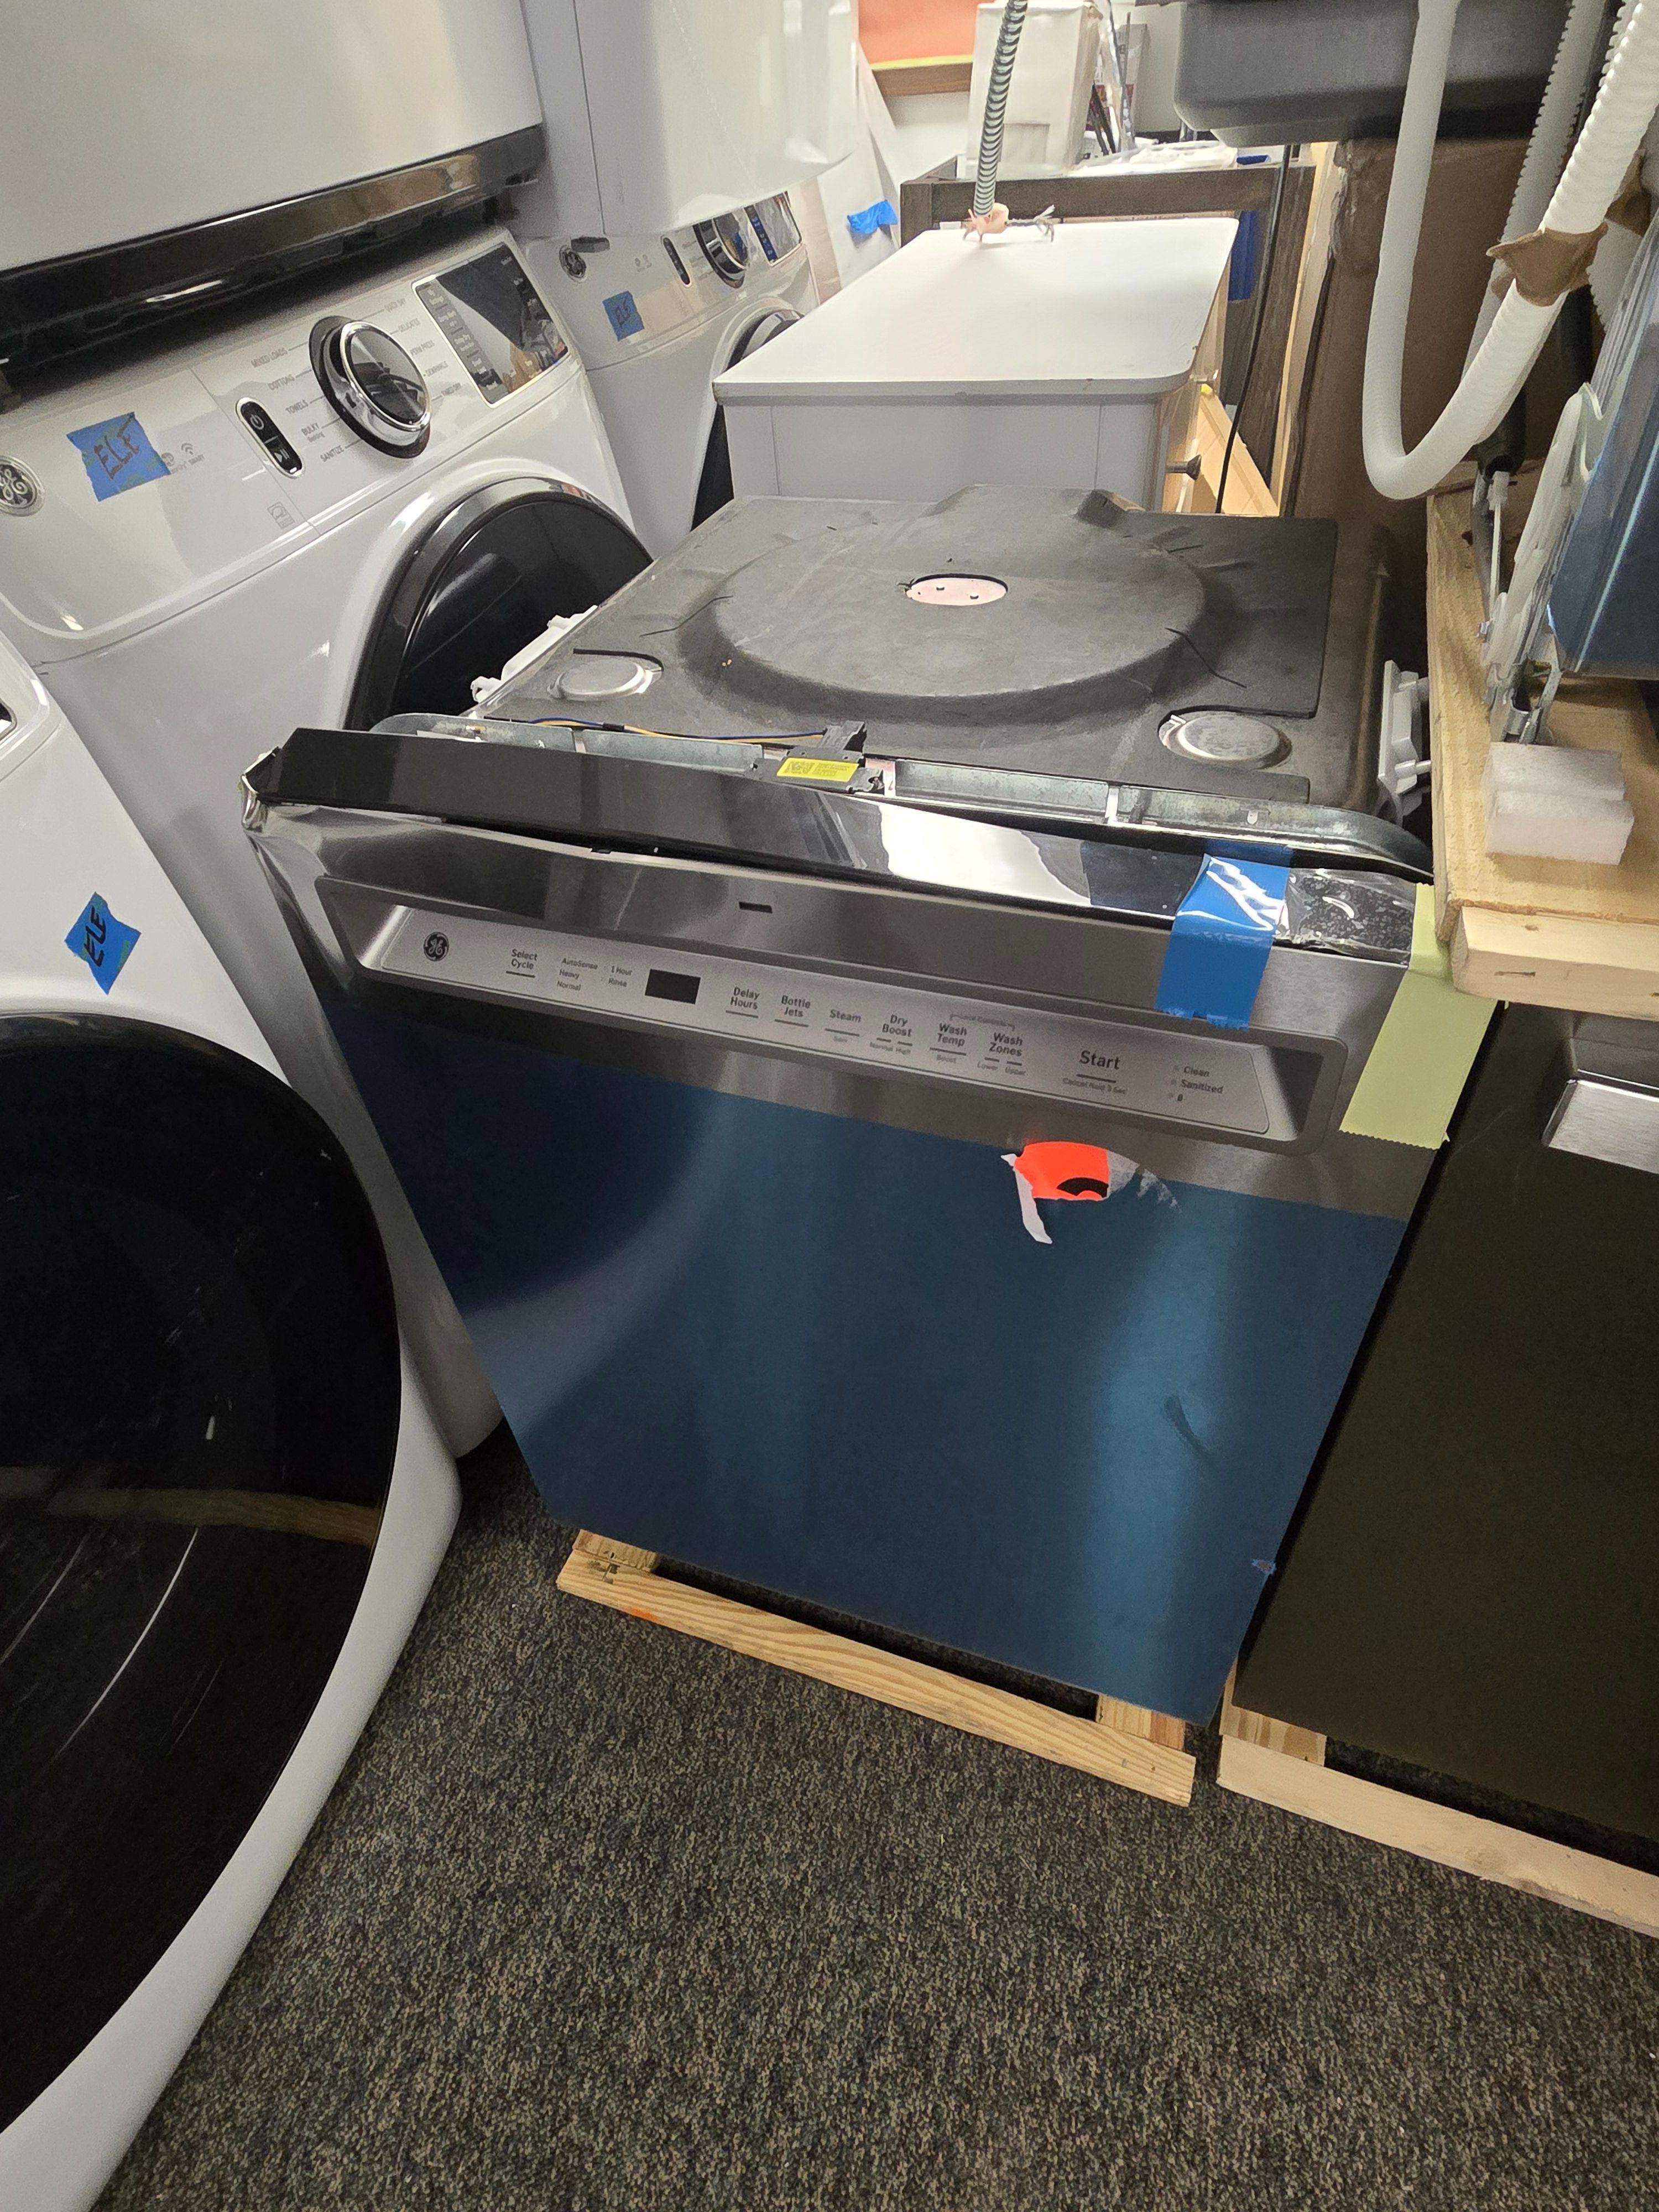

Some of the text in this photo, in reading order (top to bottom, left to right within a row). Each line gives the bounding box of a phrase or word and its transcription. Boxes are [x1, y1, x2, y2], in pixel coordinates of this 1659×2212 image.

[268, 374, 295, 390] COTTONS
[285, 399, 309, 414] TOWELS
[301, 422, 320, 436] BULKY
[93, 414, 139, 479] ELF
[320, 445, 344, 462] SANITIZE
[511, 948, 538, 961] Select
[511, 958, 534, 969] Cycle
[562, 958, 598, 969] AutoSense
[559, 969, 580, 979] Heavy
[615, 967, 633, 975] Hour
[557, 980, 581, 991] Normal
[608, 978, 627, 987] Rinse
[733, 987, 760, 1000] Delay
[731, 997, 758, 1010] Hours
[781, 995, 811, 1009] Bottle
[784, 1007, 804, 1017] Jets
[830, 1009, 862, 1022] Steam
[890, 1014, 908, 1027] Dry
[881, 1024, 912, 1037] Boost
[939, 1023, 967, 1036] Wash
[937, 1033, 965, 1047] Temp
[994, 1032, 1023, 1046] Wash
[989, 1042, 1022, 1057] Zones
[1079, 1050, 1120, 1070] Start
[1184, 1066, 1209, 1077] Clean
[1181, 1079, 1224, 1094] Sanitized
